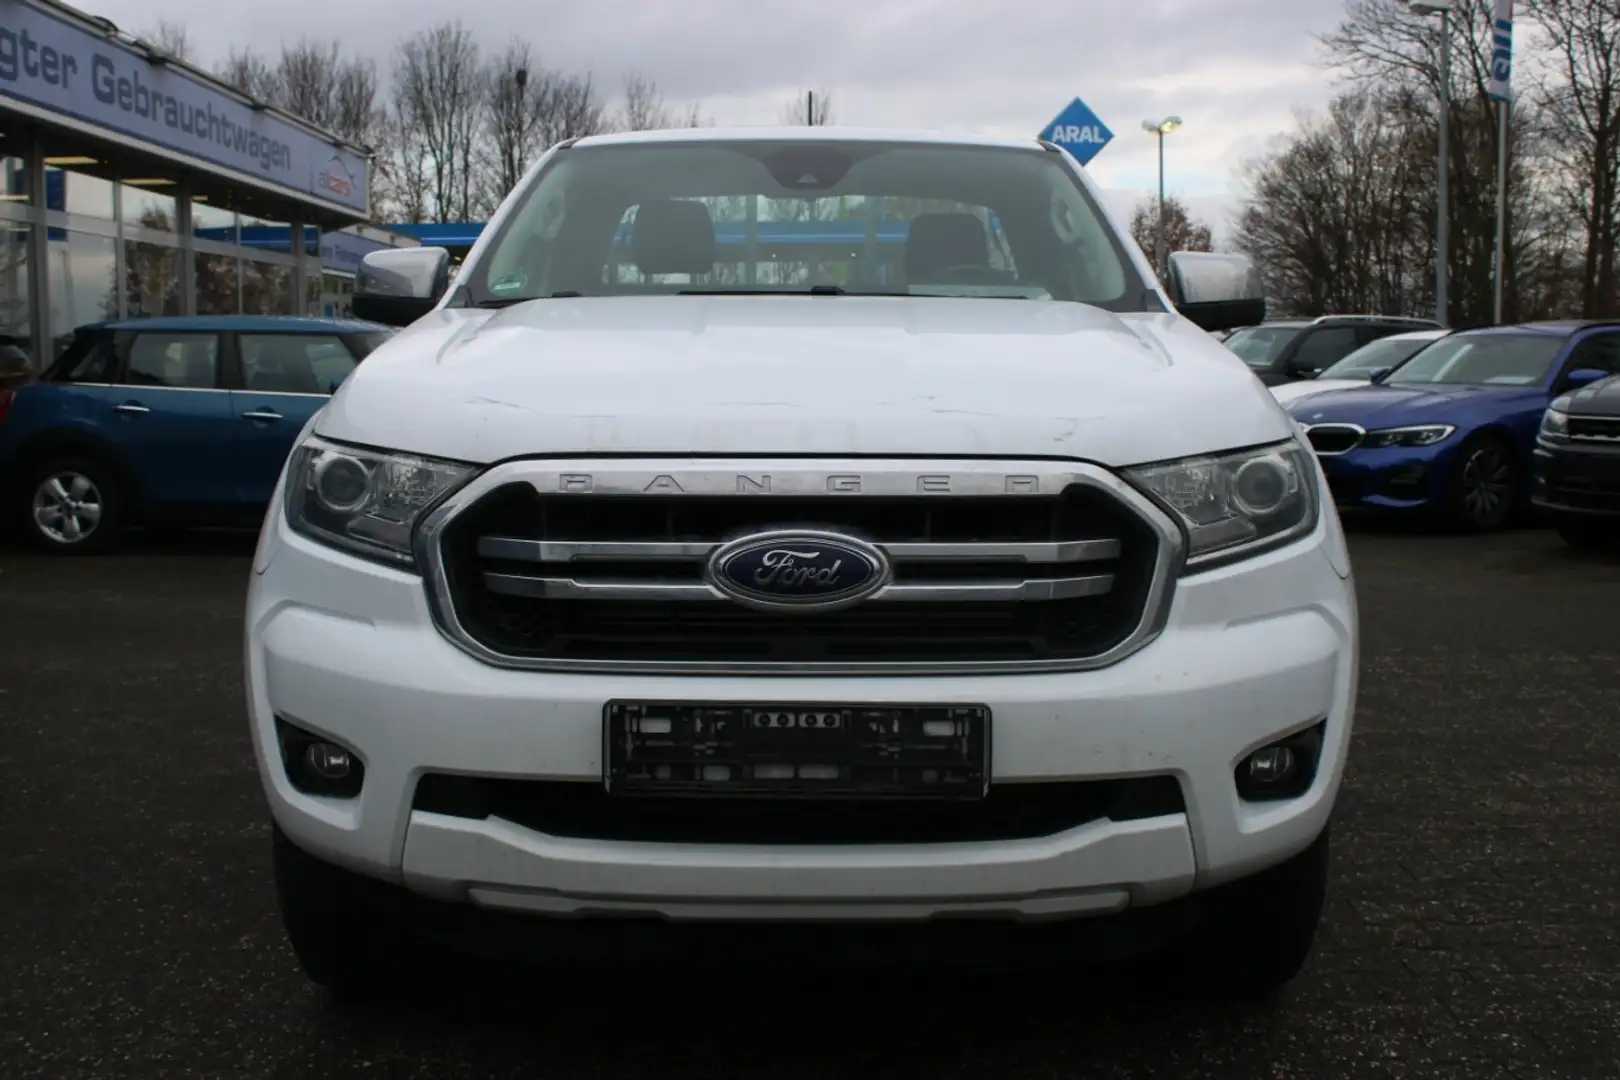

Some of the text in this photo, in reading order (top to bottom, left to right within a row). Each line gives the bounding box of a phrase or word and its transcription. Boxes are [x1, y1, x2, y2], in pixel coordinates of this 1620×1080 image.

[92, 52, 290, 170] Gebrauchtwagen
[1052, 125, 1104, 144] ARAL
[559, 473, 1040, 495] RANGER
[754, 549, 842, 585] Ford
